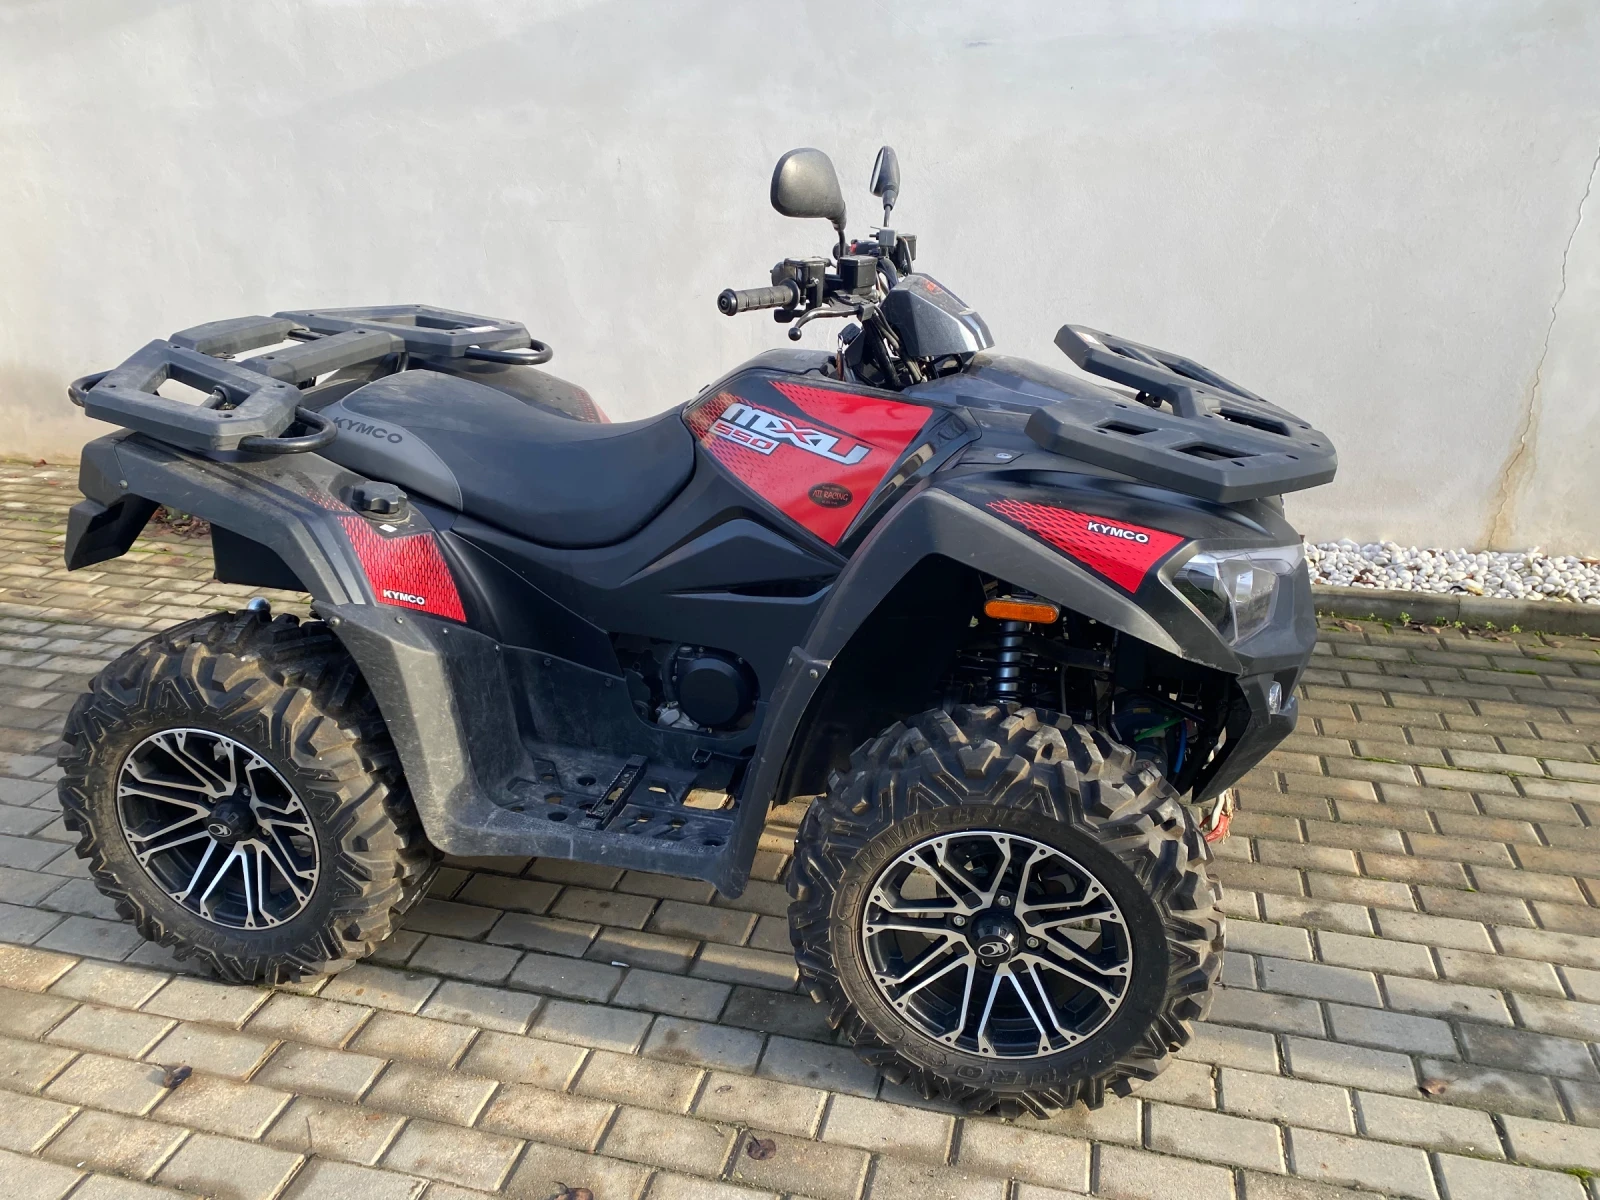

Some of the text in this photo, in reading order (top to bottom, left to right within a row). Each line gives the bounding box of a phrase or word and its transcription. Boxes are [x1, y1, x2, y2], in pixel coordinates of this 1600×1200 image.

[332, 416, 403, 444] KYMCO
[712, 422, 776, 452] 550
[718, 402, 871, 465] MXU
[1087, 521, 1149, 543] KYMCO
[383, 589, 425, 605] KYMCO
